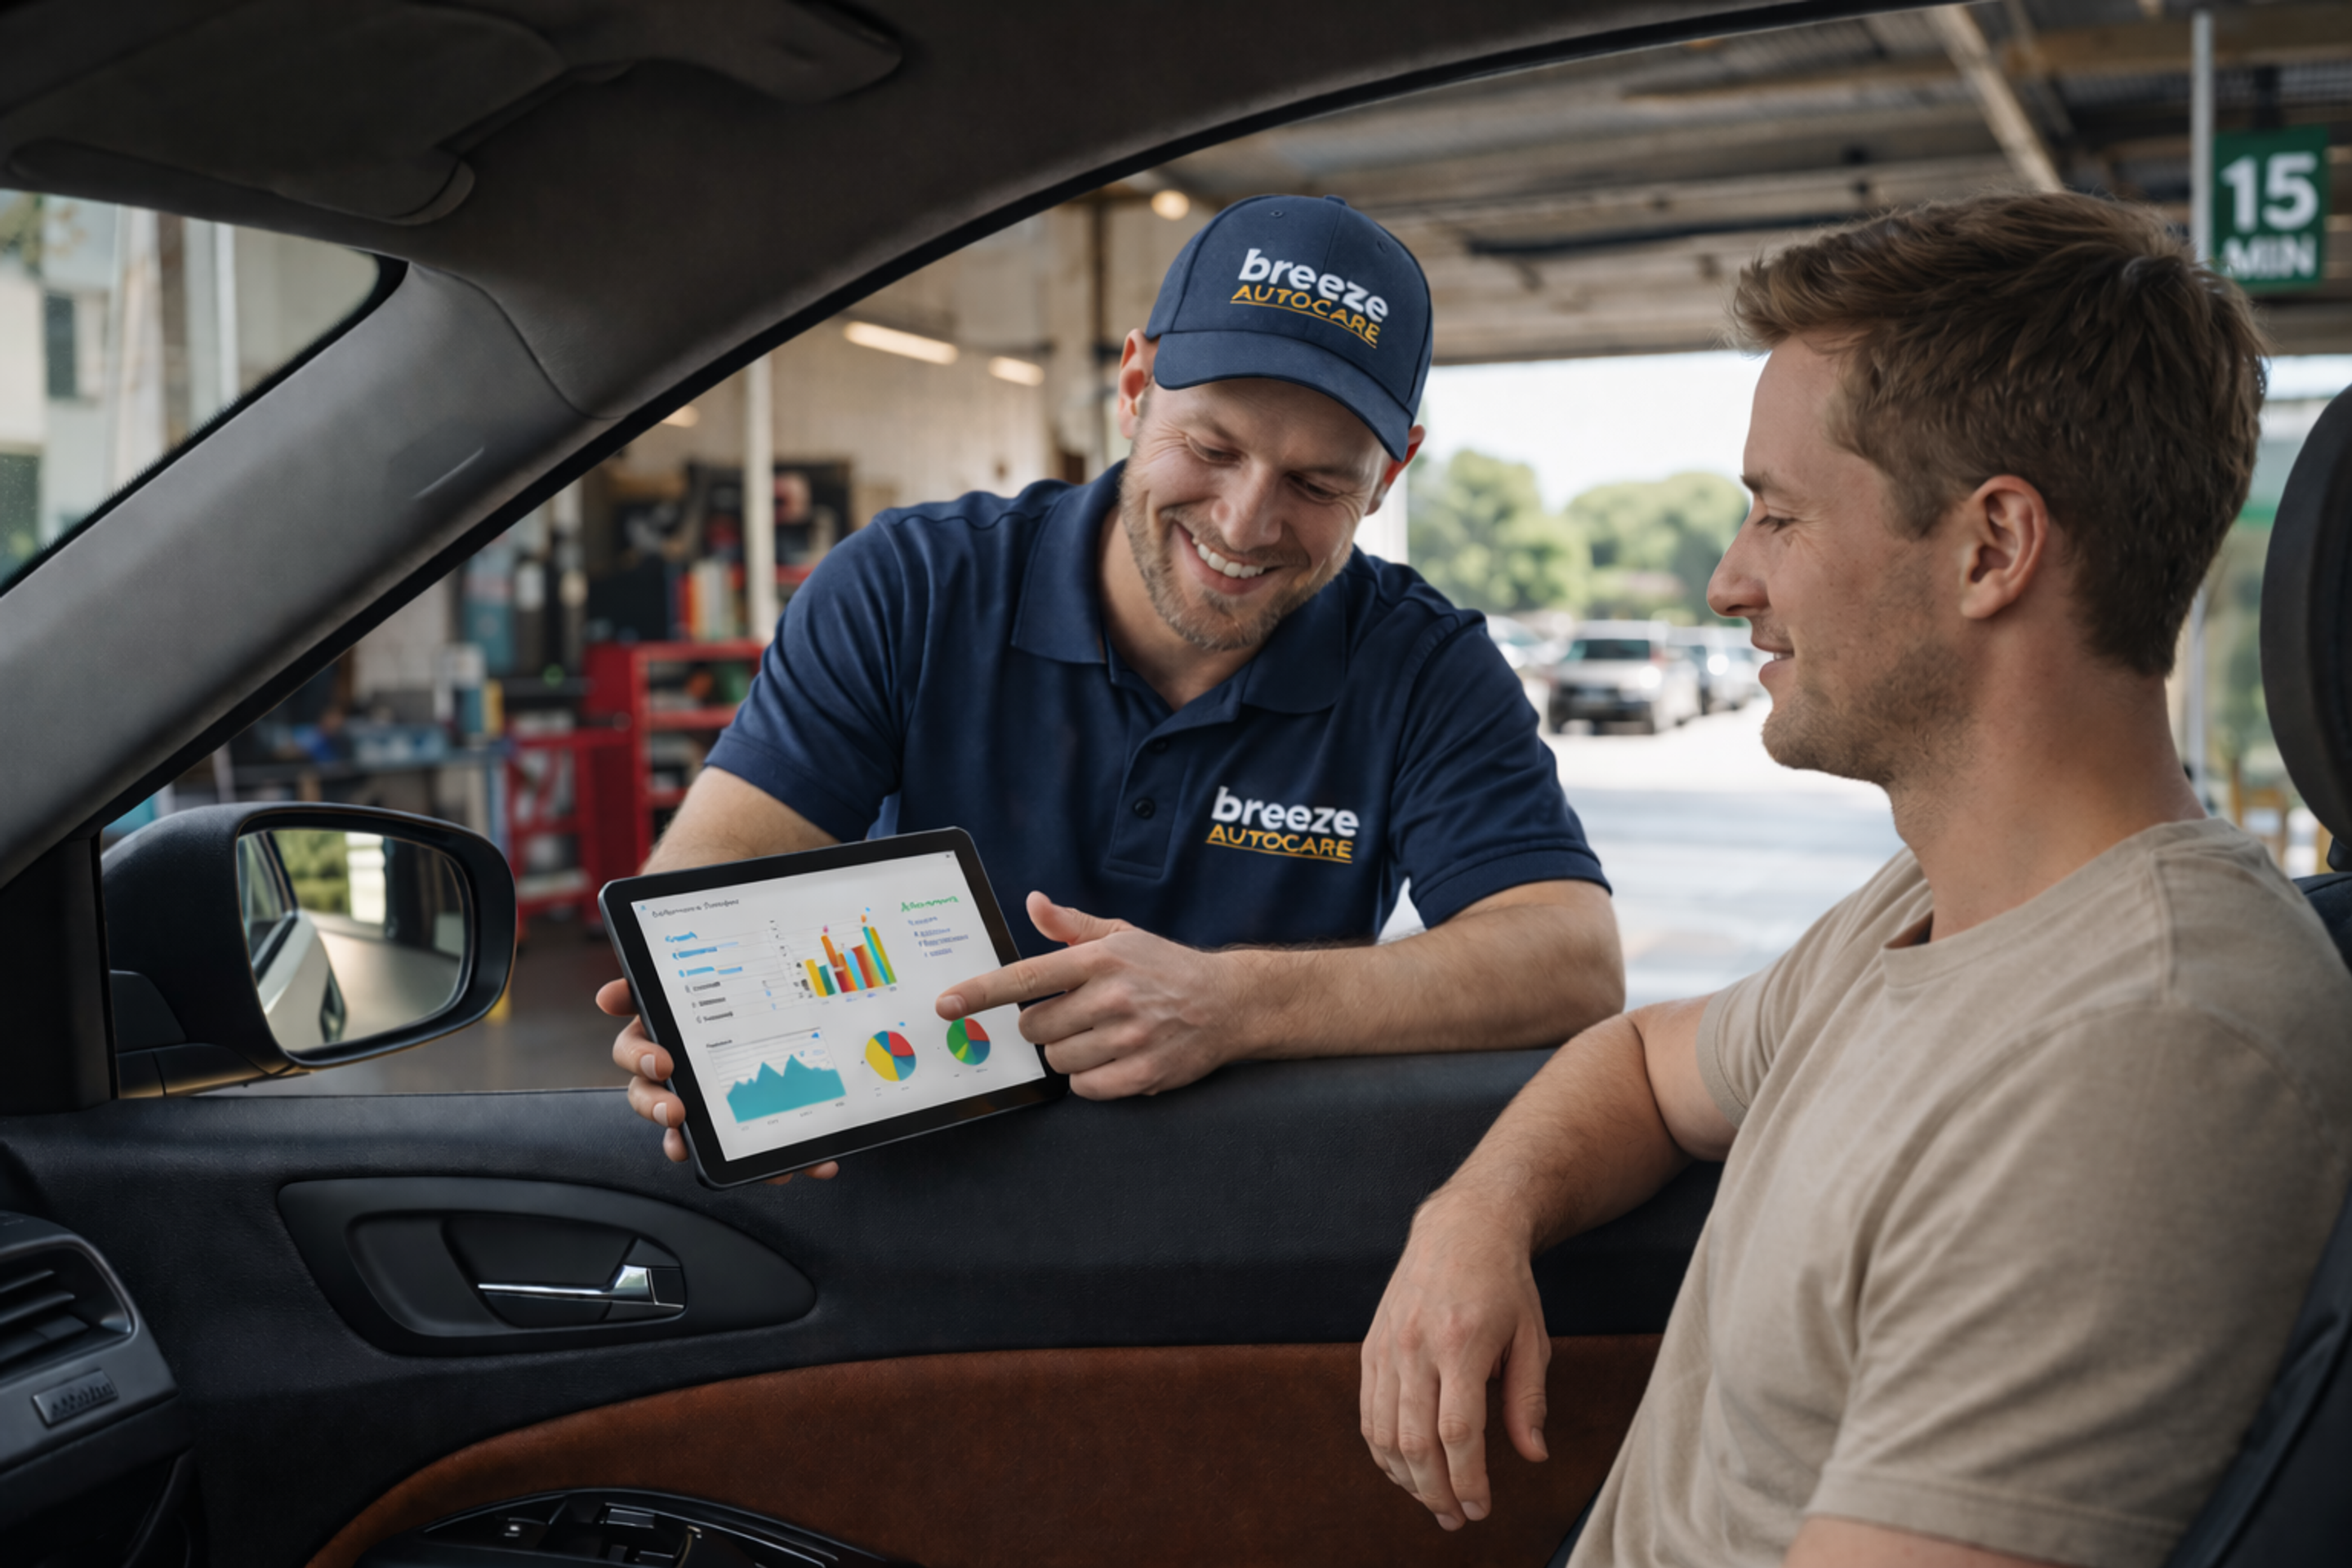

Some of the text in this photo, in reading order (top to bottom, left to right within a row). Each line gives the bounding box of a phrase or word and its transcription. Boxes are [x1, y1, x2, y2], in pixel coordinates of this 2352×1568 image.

[2220, 151, 2319, 233] 15
[2223, 234, 2318, 279] MIN
[1238, 248, 1388, 323] breeze
[1232, 284, 1381, 345] AUTOCARE
[1211, 786, 1360, 837] breeze
[1206, 823, 1354, 859] AUTOCARE
